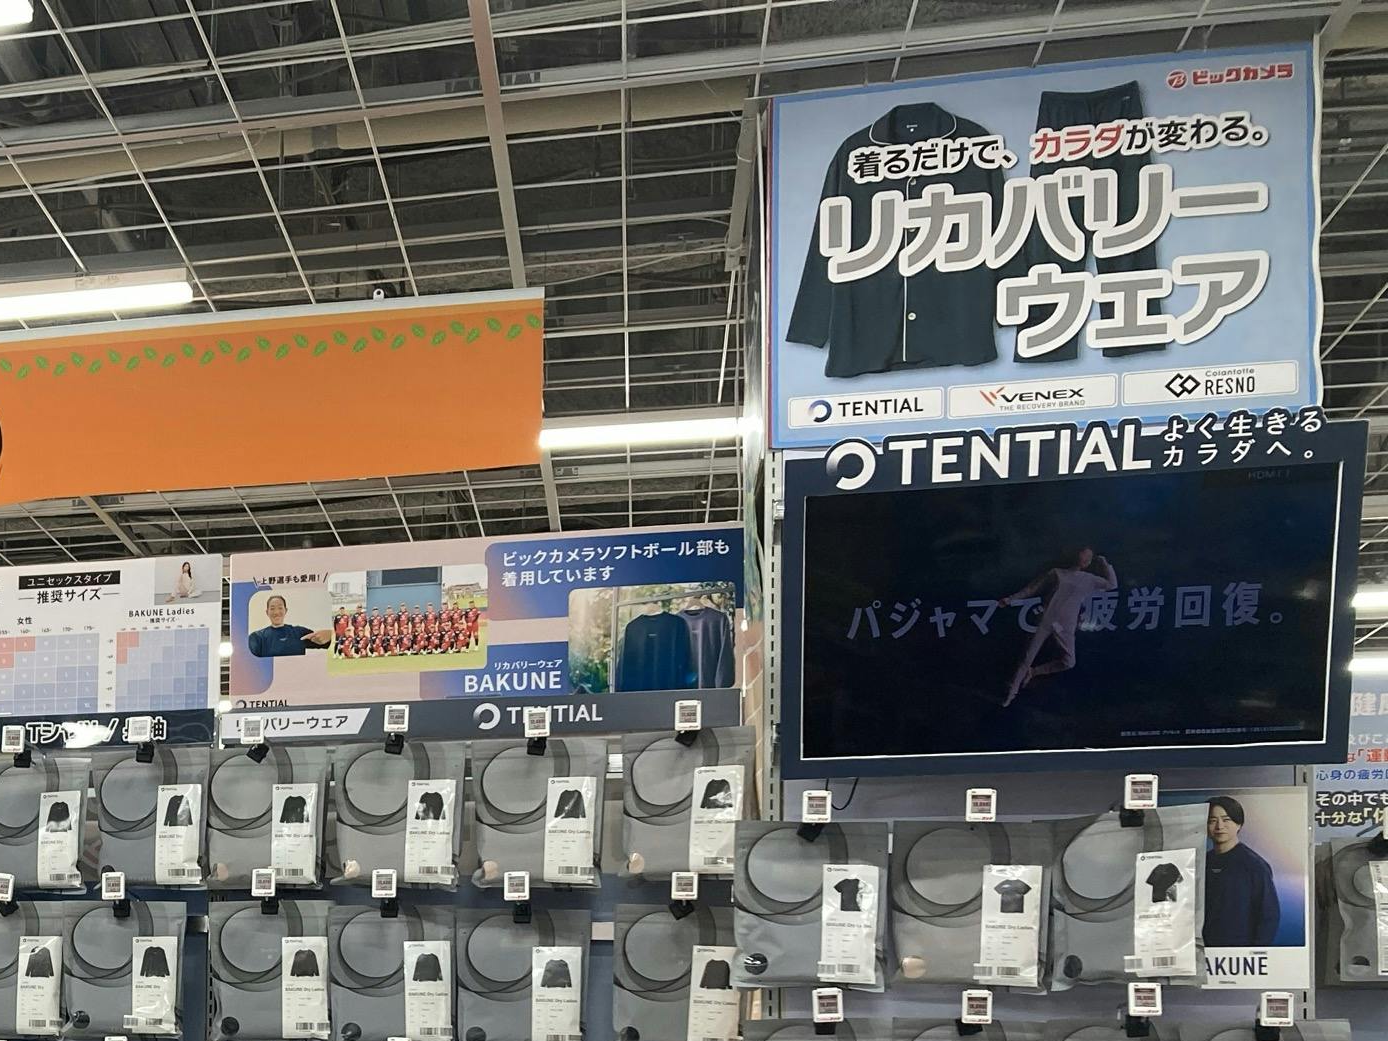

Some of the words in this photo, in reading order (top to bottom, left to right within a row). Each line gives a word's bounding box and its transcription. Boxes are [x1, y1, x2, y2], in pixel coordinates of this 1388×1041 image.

[1192, 63, 1293, 85] ビックカメラ
[851, 116, 1268, 180] 着るだけで、カラダが変わる。
[823, 167, 1267, 281] リカバリー
[1000, 252, 1268, 357] ウェア
[1204, 367, 1255, 379] Colantotte
[999, 387, 1085, 403] VENEX
[1204, 374, 1255, 396] RESNO
[838, 397, 924, 417] TENTIAL
[999, 403, 1014, 412] THE
[1015, 401, 1055, 411] RECOVERY
[1056, 399, 1086, 409] BRAND
[1163, 409, 1324, 442] よく生きる
[888, 423, 1153, 486] TENTIAL
[1162, 440, 1316, 469] カラダへ。
[502, 540, 731, 568] ビックカメラソフトボール部も
[26, 572, 113, 588] ユニセックスタイプ
[501, 566, 615, 588] 着用しています
[36, 587, 102, 605] 推奨サイズ
[128, 608, 164, 618] BAKUNE
[166, 607, 195, 616] Ladies
[493, 659, 563, 670] リカバリーウェア
[463, 670, 563, 694] BAKUNE
[250, 700, 290, 708] TENTIAL
[506, 703, 603, 725] TTIAL
[235, 714, 349, 733] バリーウェア
[1205, 956, 1269, 977] AKUNE
